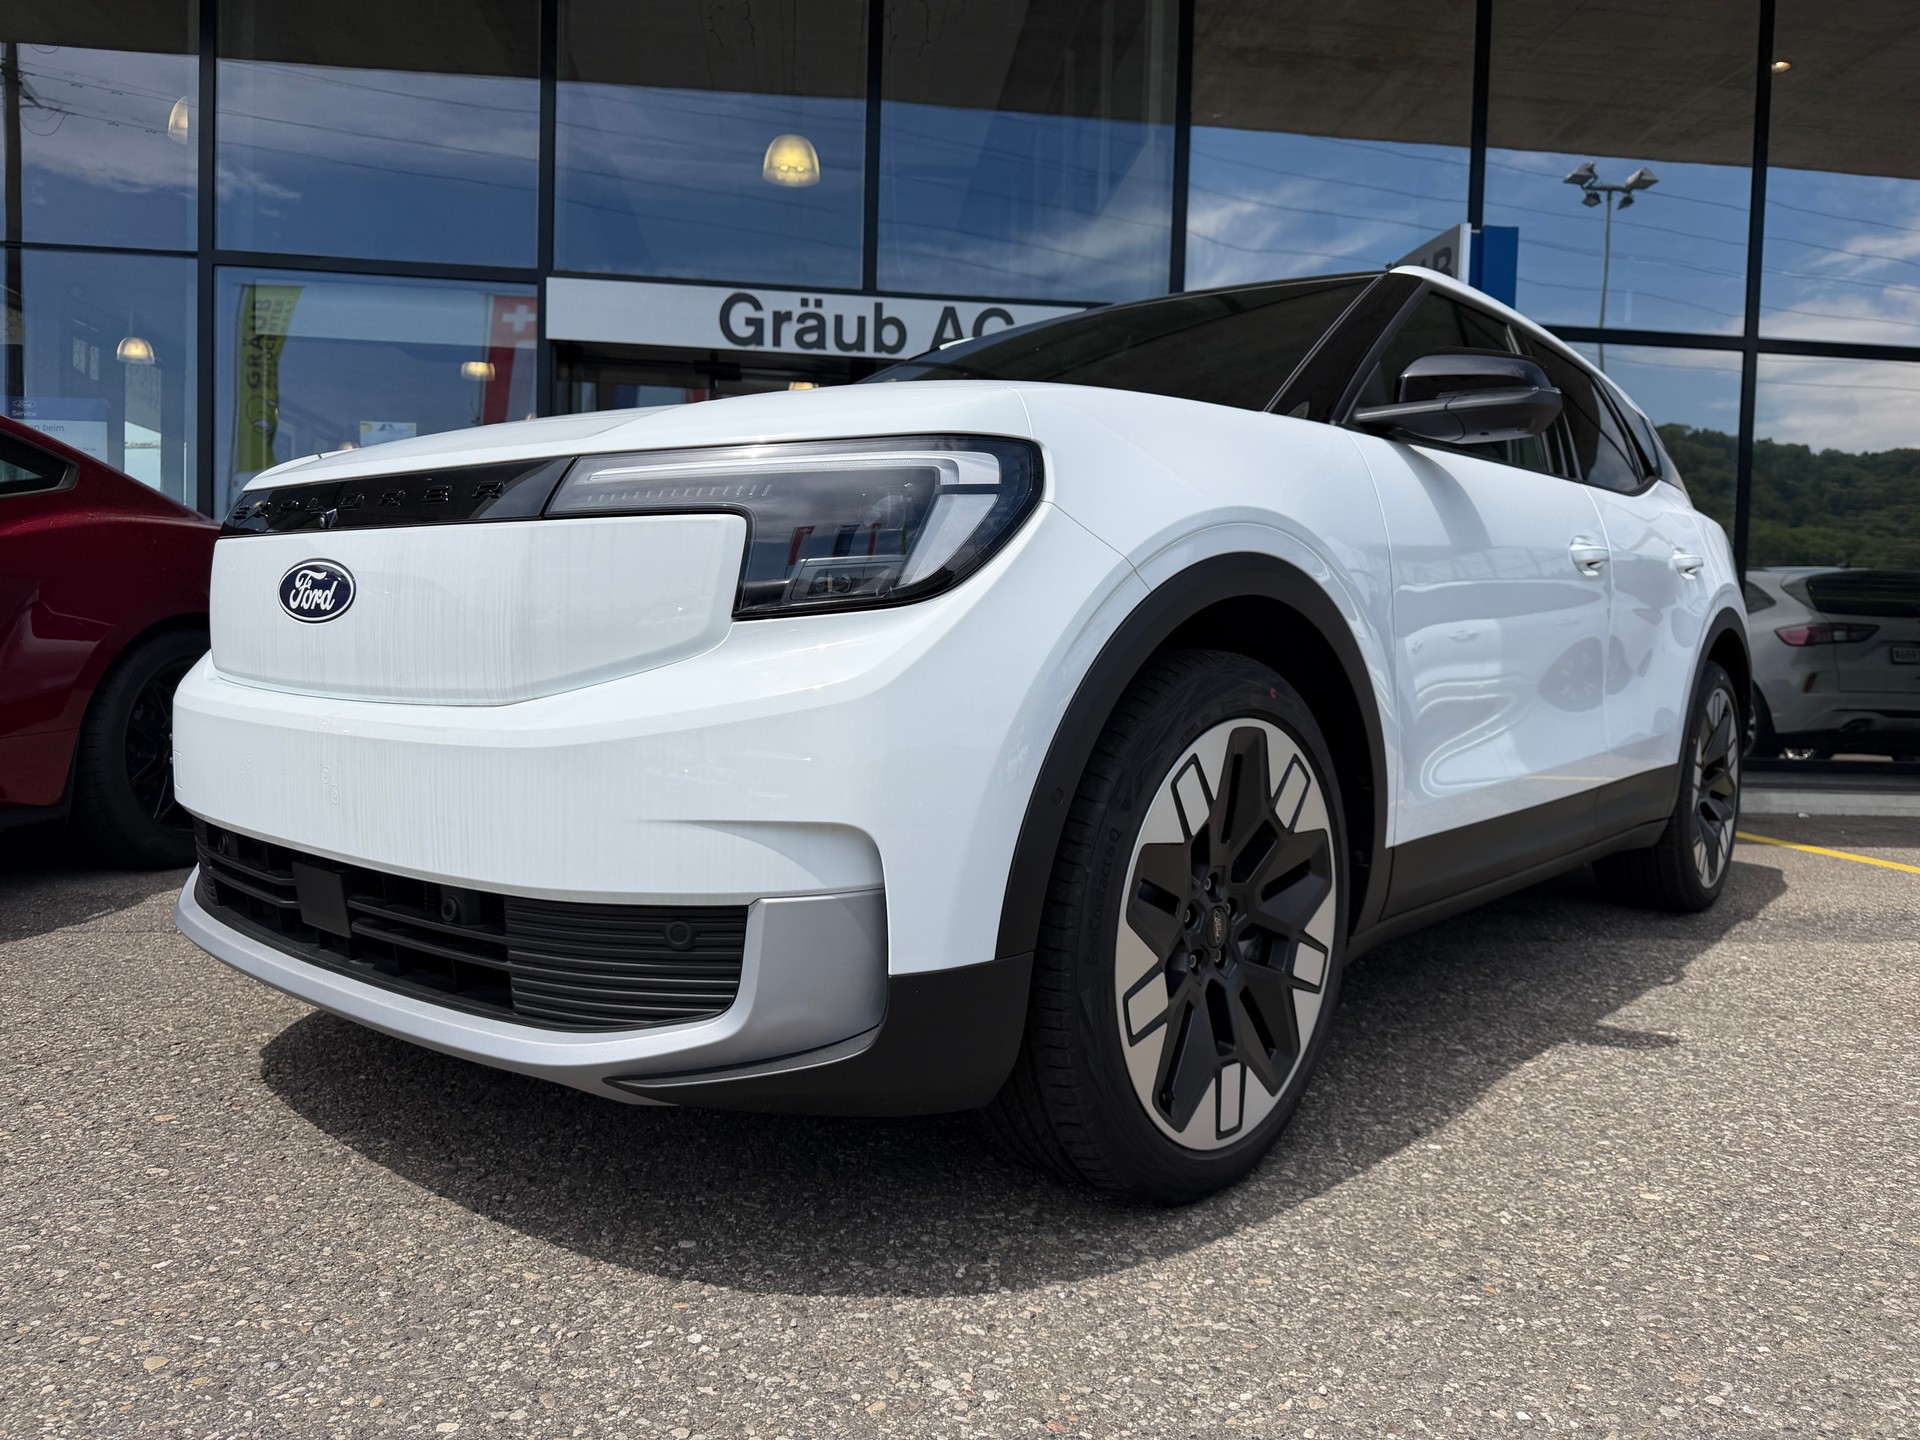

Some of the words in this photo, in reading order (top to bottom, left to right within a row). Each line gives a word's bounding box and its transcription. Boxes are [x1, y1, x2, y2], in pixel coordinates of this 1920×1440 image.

[243, 299, 272, 390] GRÄUB
[719, 292, 907, 355] Gräub
[42, 423, 65, 431] beim
[233, 481, 505, 520] EXPLORER
[289, 569, 338, 611] Ford
[1086, 857, 1112, 966] EcoContact
